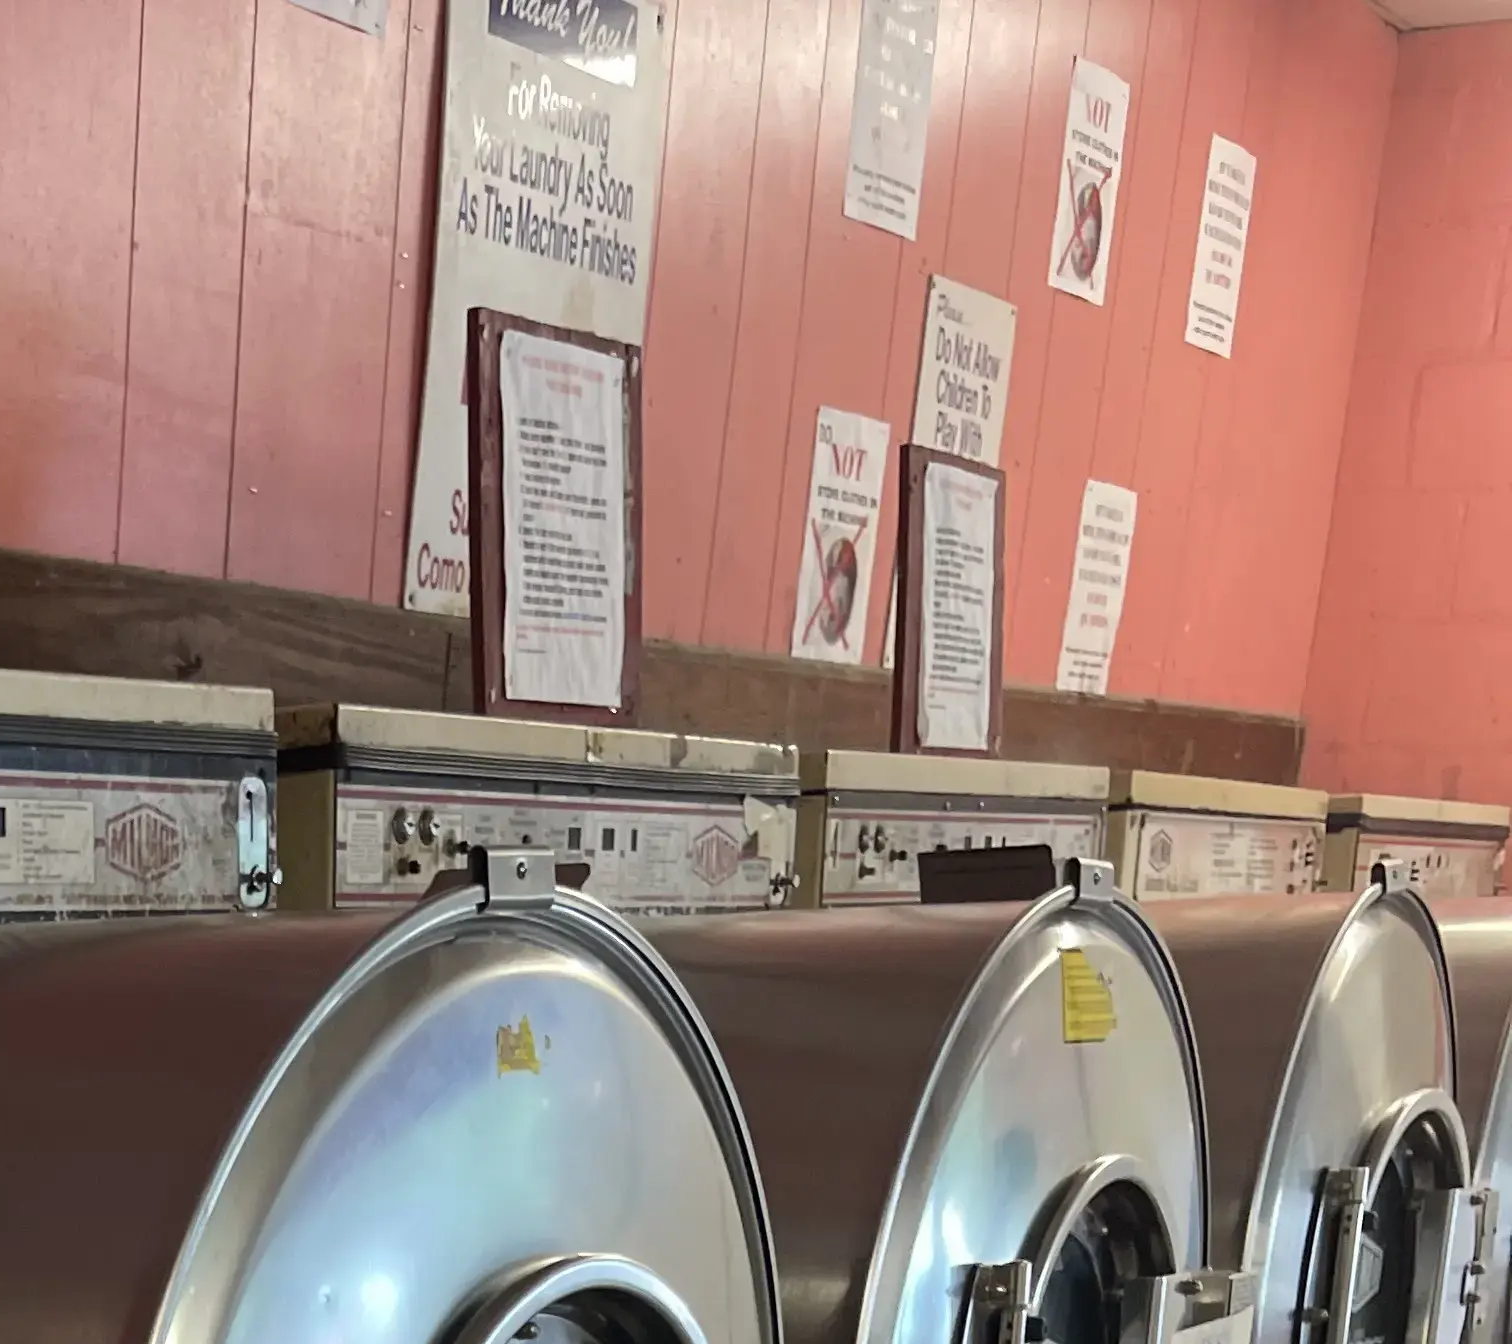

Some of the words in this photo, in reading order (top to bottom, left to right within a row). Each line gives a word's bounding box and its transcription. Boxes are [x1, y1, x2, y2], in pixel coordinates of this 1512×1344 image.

[538, 74, 610, 160] Removing
[473, 113, 506, 177] Your
[509, 128, 573, 217] Laundry
[575, 152, 594, 208] As
[597, 162, 634, 222] Soon
[456, 177, 479, 235] As
[484, 184, 513, 245] The
[516, 196, 578, 266] Machine
[580, 218, 637, 285] Finishes
[936, 327, 951, 364] Do
[953, 332, 973, 370] Not
[973, 341, 1002, 382] Allow
[937, 369, 978, 414] Children
[981, 384, 992, 420] To
[936, 410, 958, 448] Play
[417, 542, 465, 593] Como
